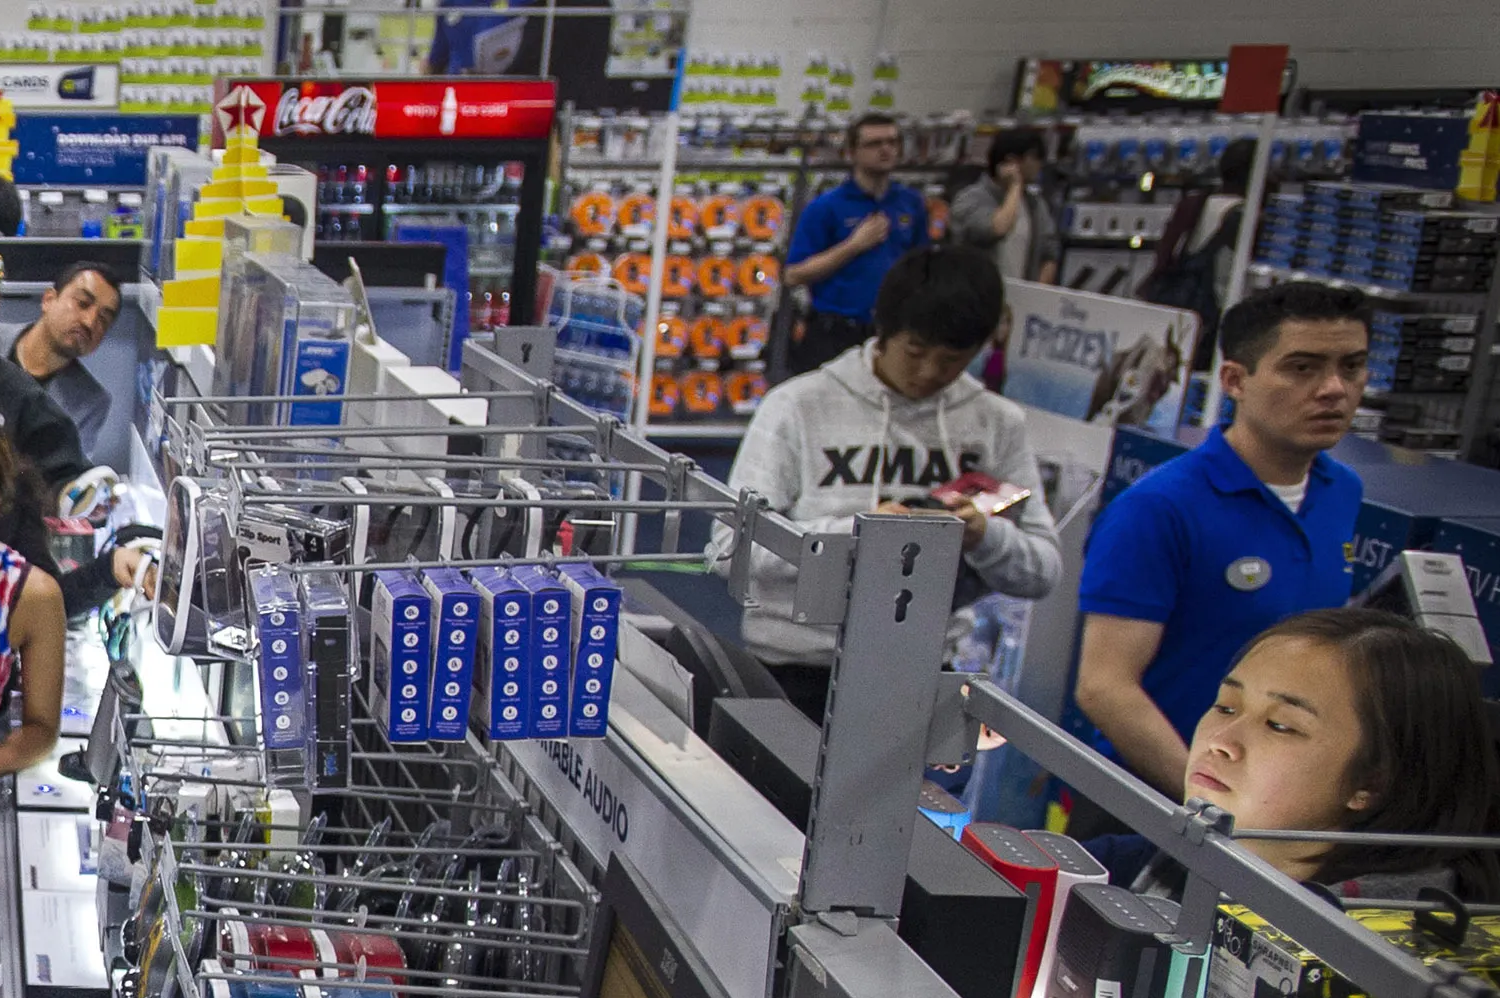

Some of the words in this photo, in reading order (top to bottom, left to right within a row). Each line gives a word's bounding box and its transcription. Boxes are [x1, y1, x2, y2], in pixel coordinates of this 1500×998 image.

[1, 75, 50, 88] CARDS
[257, 531, 282, 546] Sport
[310, 537, 318, 547] 4
[583, 767, 629, 844] AUDIO
[1252, 938, 1296, 974] SHRAPNEL
